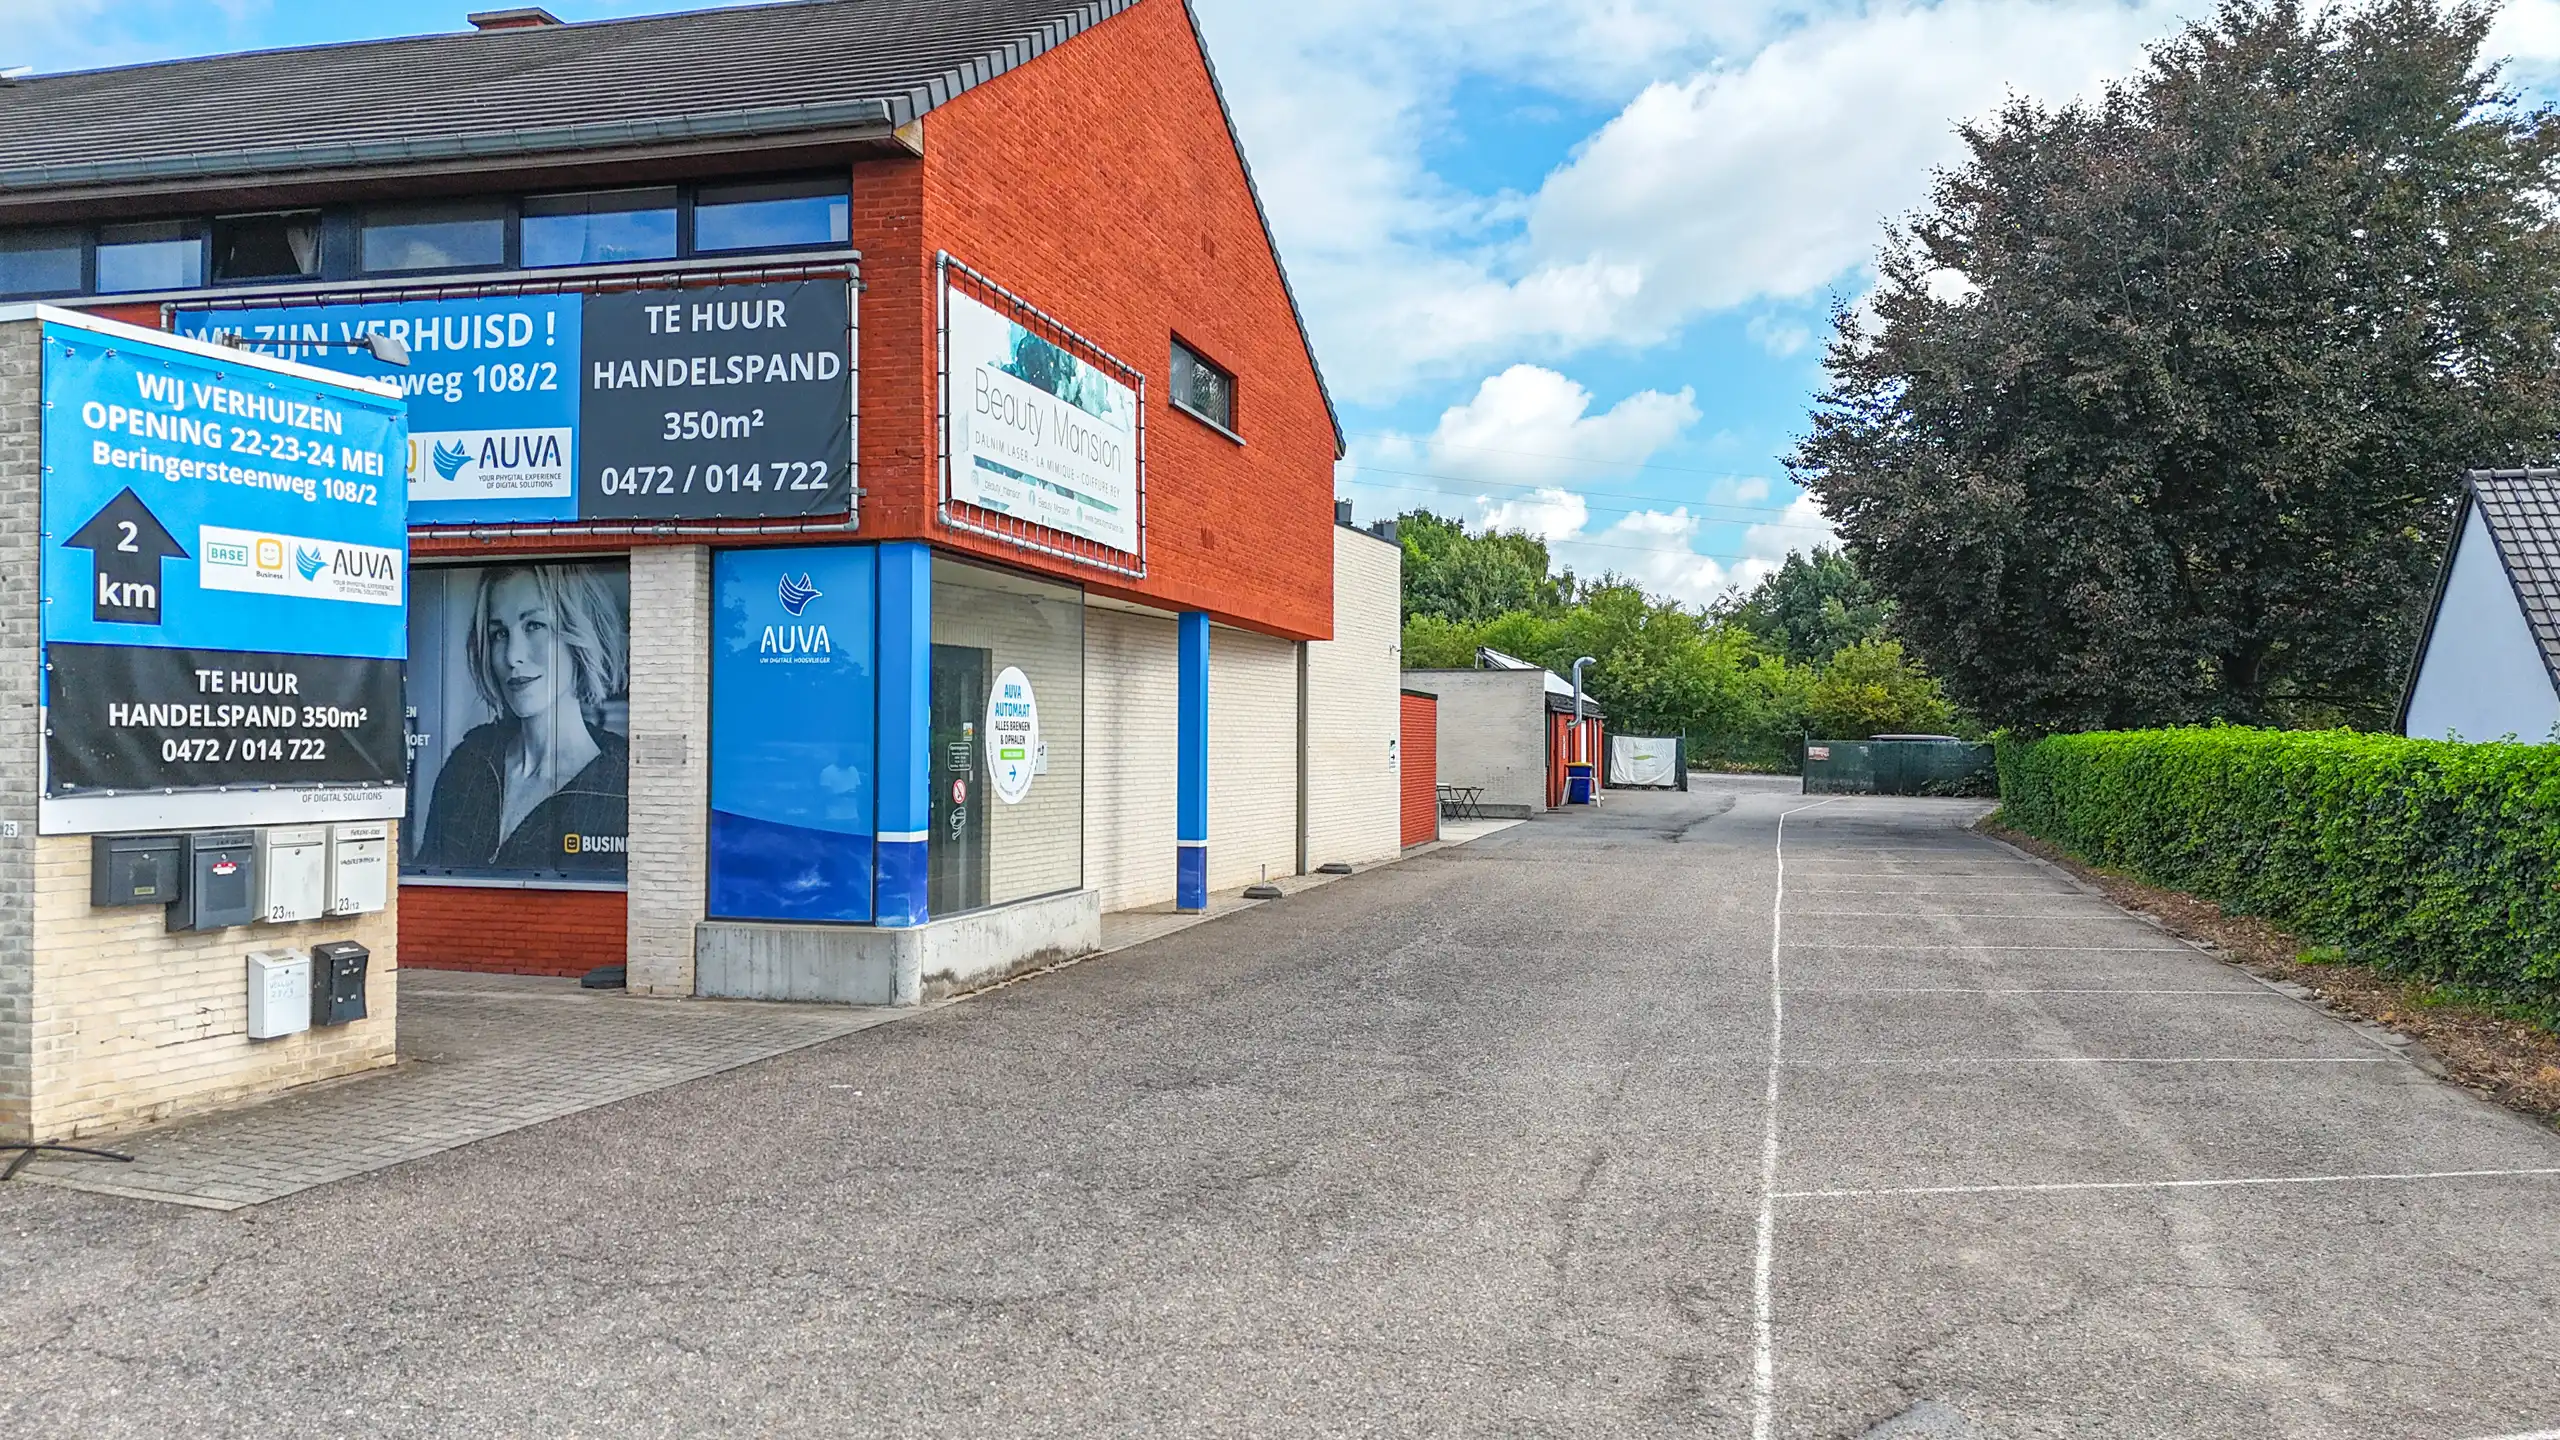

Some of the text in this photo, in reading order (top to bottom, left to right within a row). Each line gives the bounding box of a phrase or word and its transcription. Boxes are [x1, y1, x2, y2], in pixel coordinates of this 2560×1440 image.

[644, 299, 787, 334] TE HUUR
[255, 323, 328, 362] ZIJN
[545, 311, 556, 347] !
[473, 361, 558, 394] 108/2
[593, 351, 840, 390] HANDELSPAND
[136, 371, 342, 435] WIJ VERHUIZEN
[663, 408, 764, 441] 350m²
[975, 367, 1121, 473] Beauty Mansion
[82, 401, 384, 478] OPENING 22-23-24 MEI
[478, 435, 562, 469] AUVA
[975, 430, 1005, 454] DALNIM
[1007, 443, 1029, 463] LASER
[1036, 455, 1045, 469] LA
[93, 440, 378, 507] Beringersteenweg 108/2
[478, 474, 495, 482] YOUR
[525, 472, 562, 480] EXPERIENCE
[495, 481, 518, 489] DIGITAL
[519, 480, 553, 488] SOLUTIONS
[601, 460, 829, 496] 0472 / 014 722
[117, 520, 139, 553] 2
[211, 547, 244, 562] BASE
[332, 548, 395, 581] AUVA
[99, 572, 156, 609] km
[256, 570, 283, 580] Business
[760, 625, 831, 654] AUVA
[195, 669, 299, 696] TE HUUR
[1004, 684, 1022, 699] AUVA
[109, 703, 296, 729] HANDELSPAND
[995, 702, 1030, 718] AUTOMAAT
[995, 720, 1030, 732] ALLES BRENGEN
[162, 738, 326, 763] 0472 / 014 722
[1005, 734, 1026, 745] OPHALEN
[302, 791, 383, 803] OF DIGITAL SOLUTIONS
